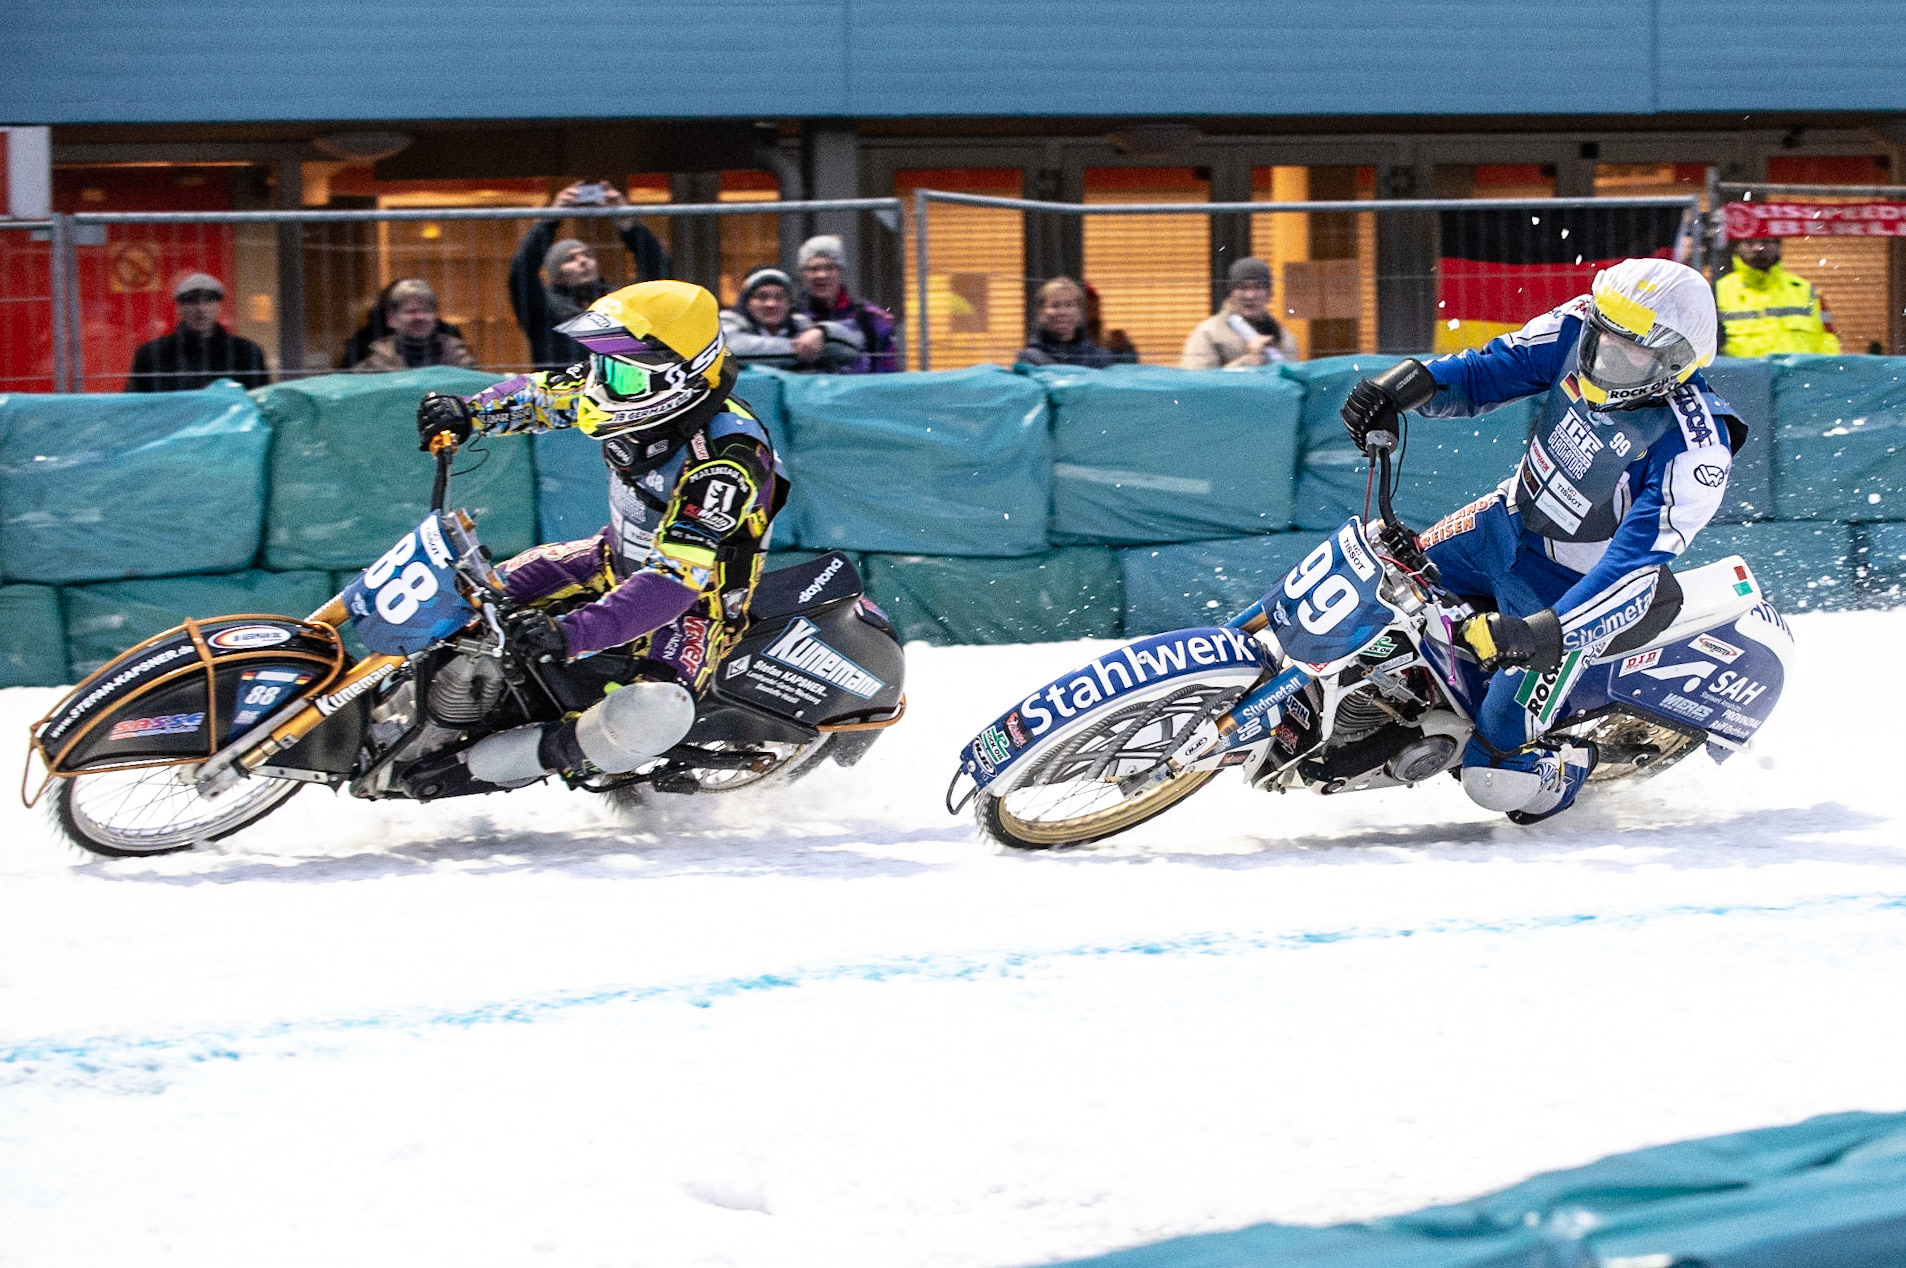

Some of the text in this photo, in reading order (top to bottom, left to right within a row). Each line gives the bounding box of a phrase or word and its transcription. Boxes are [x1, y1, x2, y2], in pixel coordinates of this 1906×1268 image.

[1610, 387, 1647, 399] ROCK
[628, 401, 673, 421] GERMAN
[1561, 412, 1604, 460] ICE
[1608, 431, 1632, 458] 99
[1557, 482, 1583, 509] TISSOT
[1422, 517, 1475, 548] REISEN
[1343, 538, 1366, 571] TISSOT
[363, 532, 439, 625] 88
[798, 557, 844, 604] daytona
[1283, 540, 1360, 636] 99
[1563, 579, 1657, 648] Südmetal
[752, 660, 783, 678] Stefan
[1020, 627, 1257, 737] Stahlwerk
[243, 684, 282, 706] 88
[1708, 670, 1768, 706] SAH
[1660, 692, 1714, 718] WIERES
